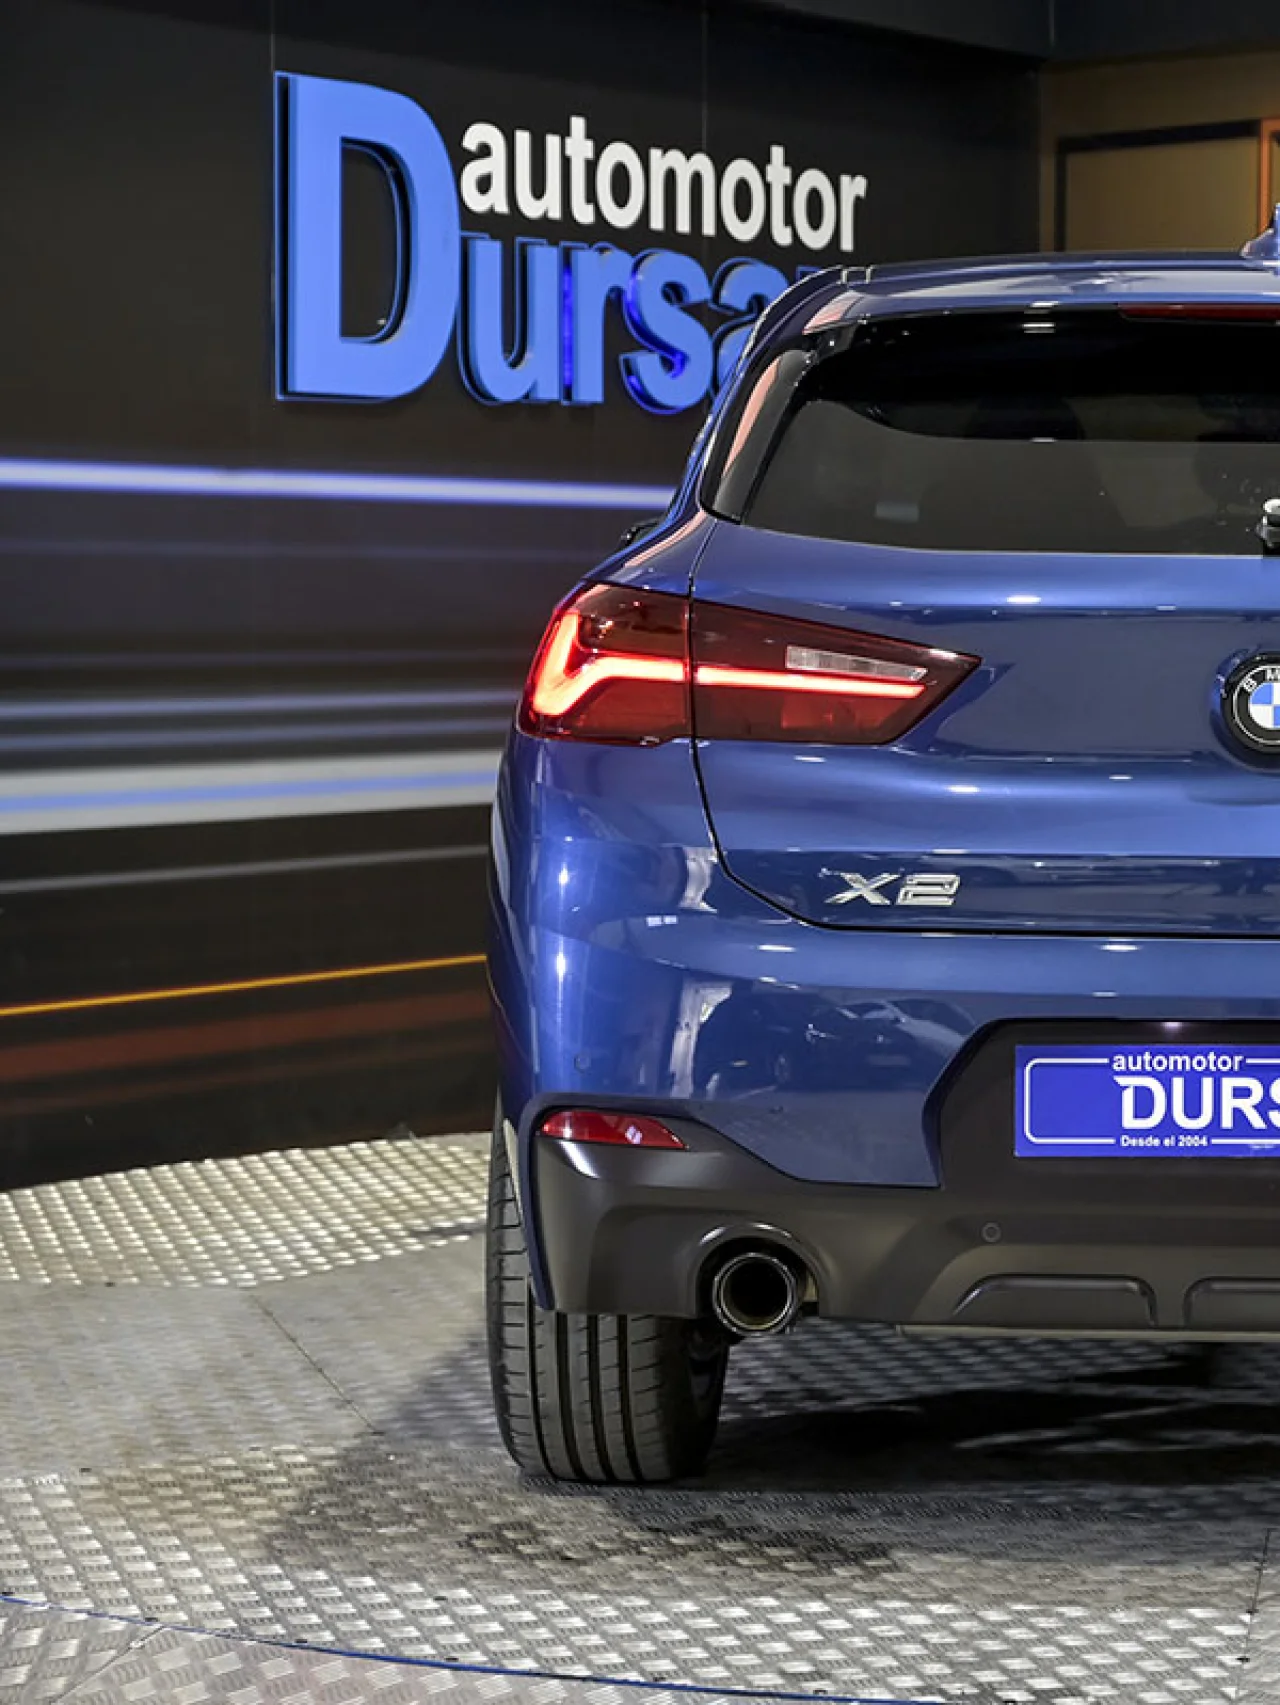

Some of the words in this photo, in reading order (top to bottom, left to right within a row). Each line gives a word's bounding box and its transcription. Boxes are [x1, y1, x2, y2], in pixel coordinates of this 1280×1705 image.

[461, 115, 868, 252] automotor
[274, 70, 828, 415] Dursa
[823, 873, 961, 906] X2
[1112, 1051, 1244, 1072] automotor
[1121, 1134, 1160, 1147] Desde
[1163, 1134, 1176, 1147] el
[1177, 1134, 1208, 1147] 2004
